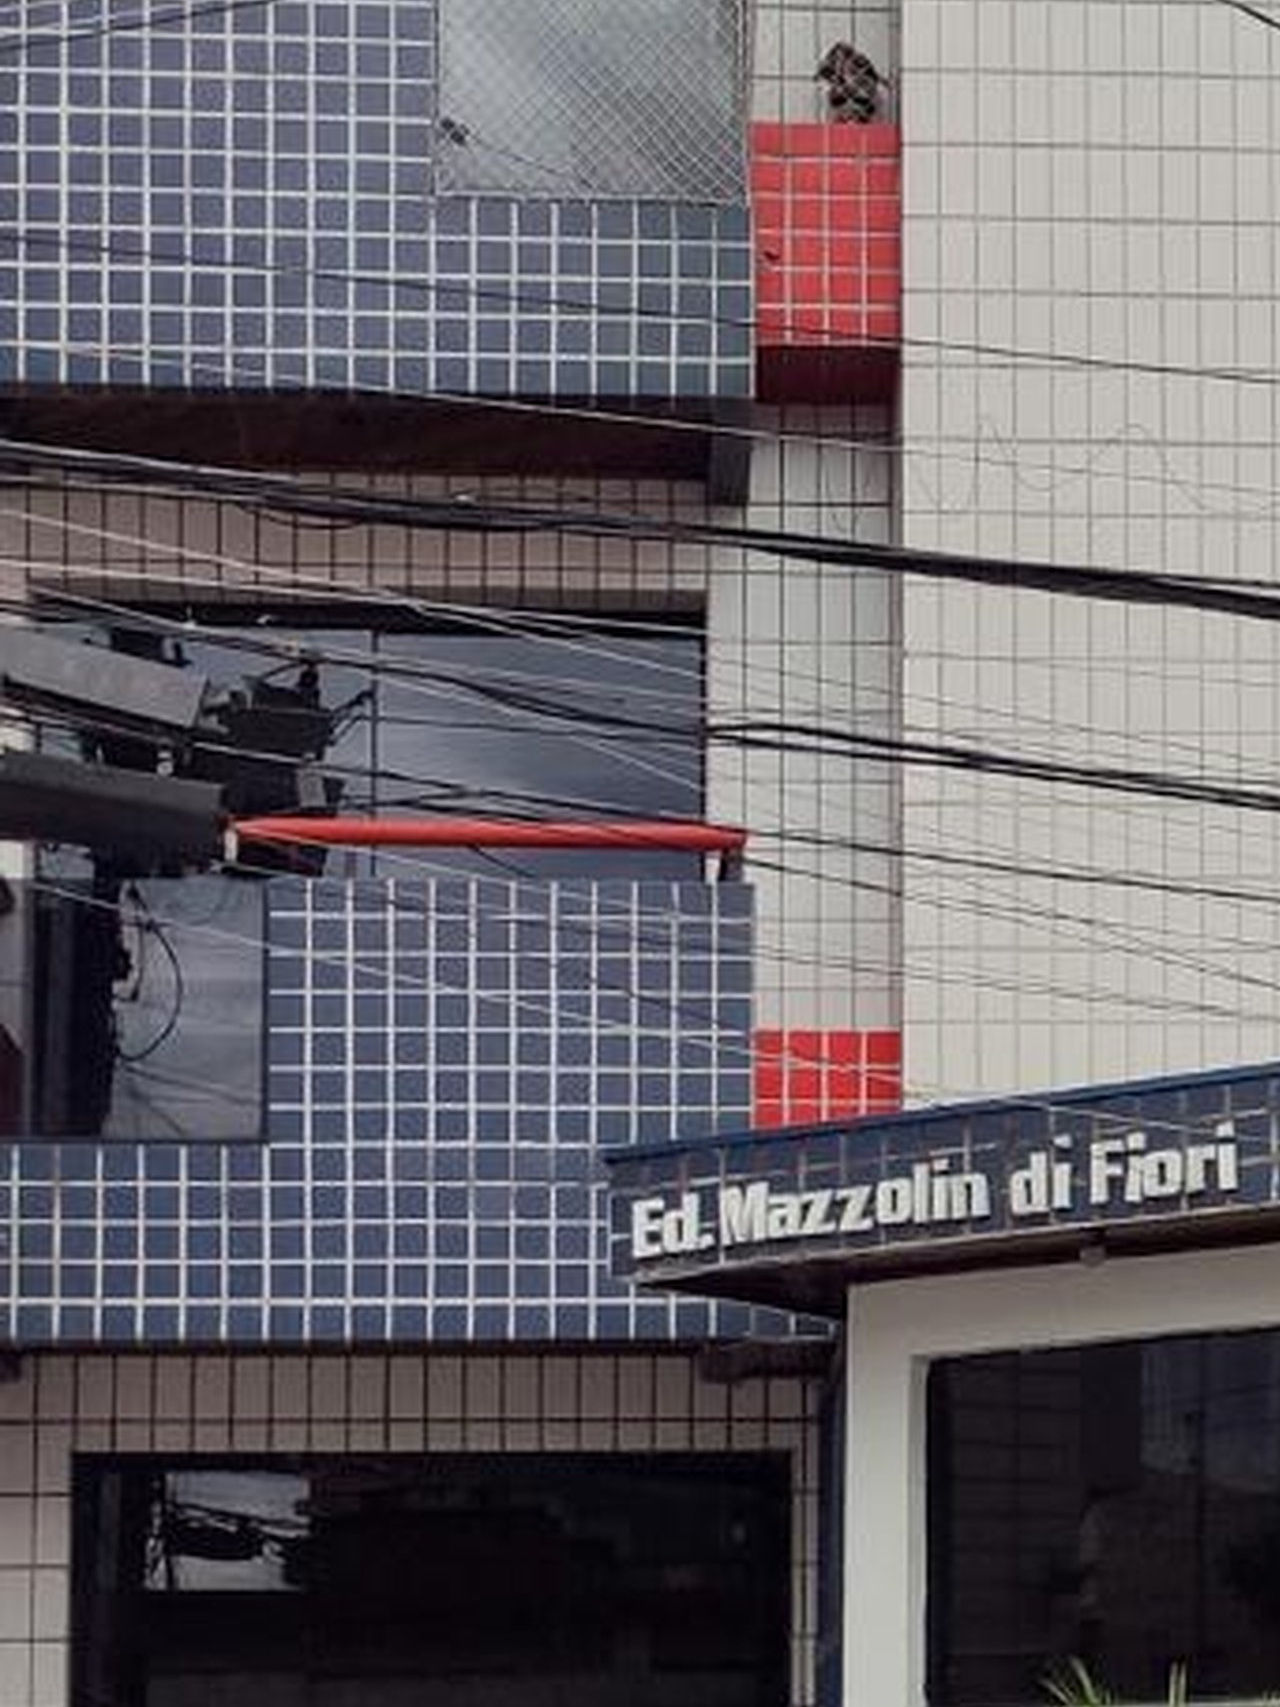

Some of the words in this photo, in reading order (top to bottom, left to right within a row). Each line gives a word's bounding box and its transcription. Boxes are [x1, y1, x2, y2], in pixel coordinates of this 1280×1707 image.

[632, 1192, 715, 1258] Ed.
[720, 1158, 990, 1244] Mazzolin
[1010, 1133, 1072, 1216] di
[1090, 1120, 1238, 1203] Fiori
